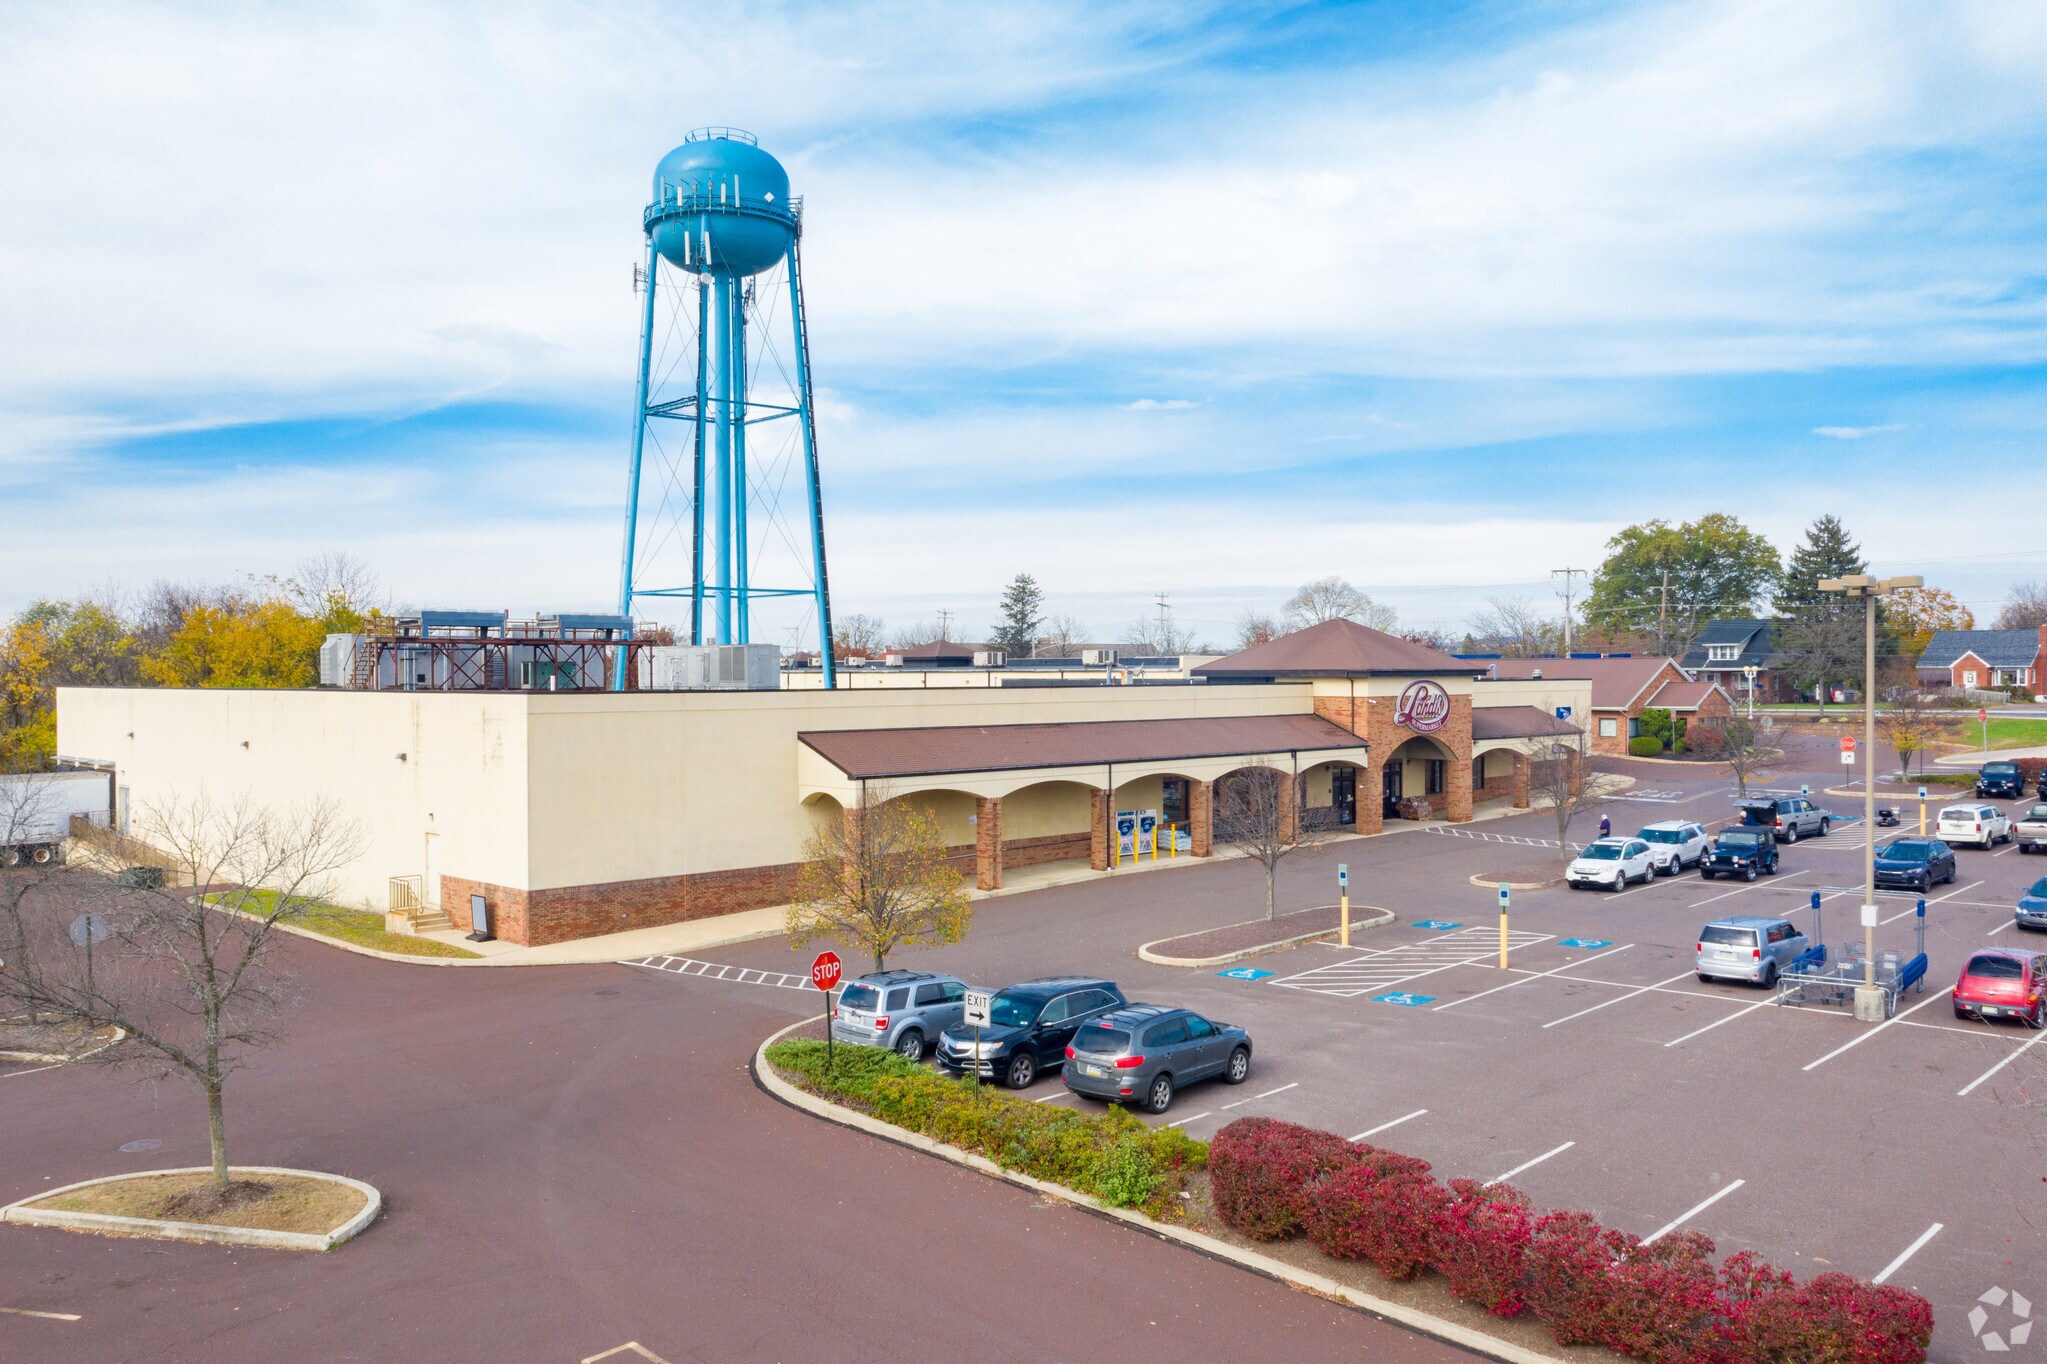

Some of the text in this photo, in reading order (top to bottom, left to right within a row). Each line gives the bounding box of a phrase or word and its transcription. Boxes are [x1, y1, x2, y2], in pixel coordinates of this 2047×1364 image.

[1411, 718, 1443, 731] SUPERMARKET
[1840, 740, 1856, 748] STOP
[813, 961, 840, 981] STOP
[967, 994, 987, 1008] EXIT
